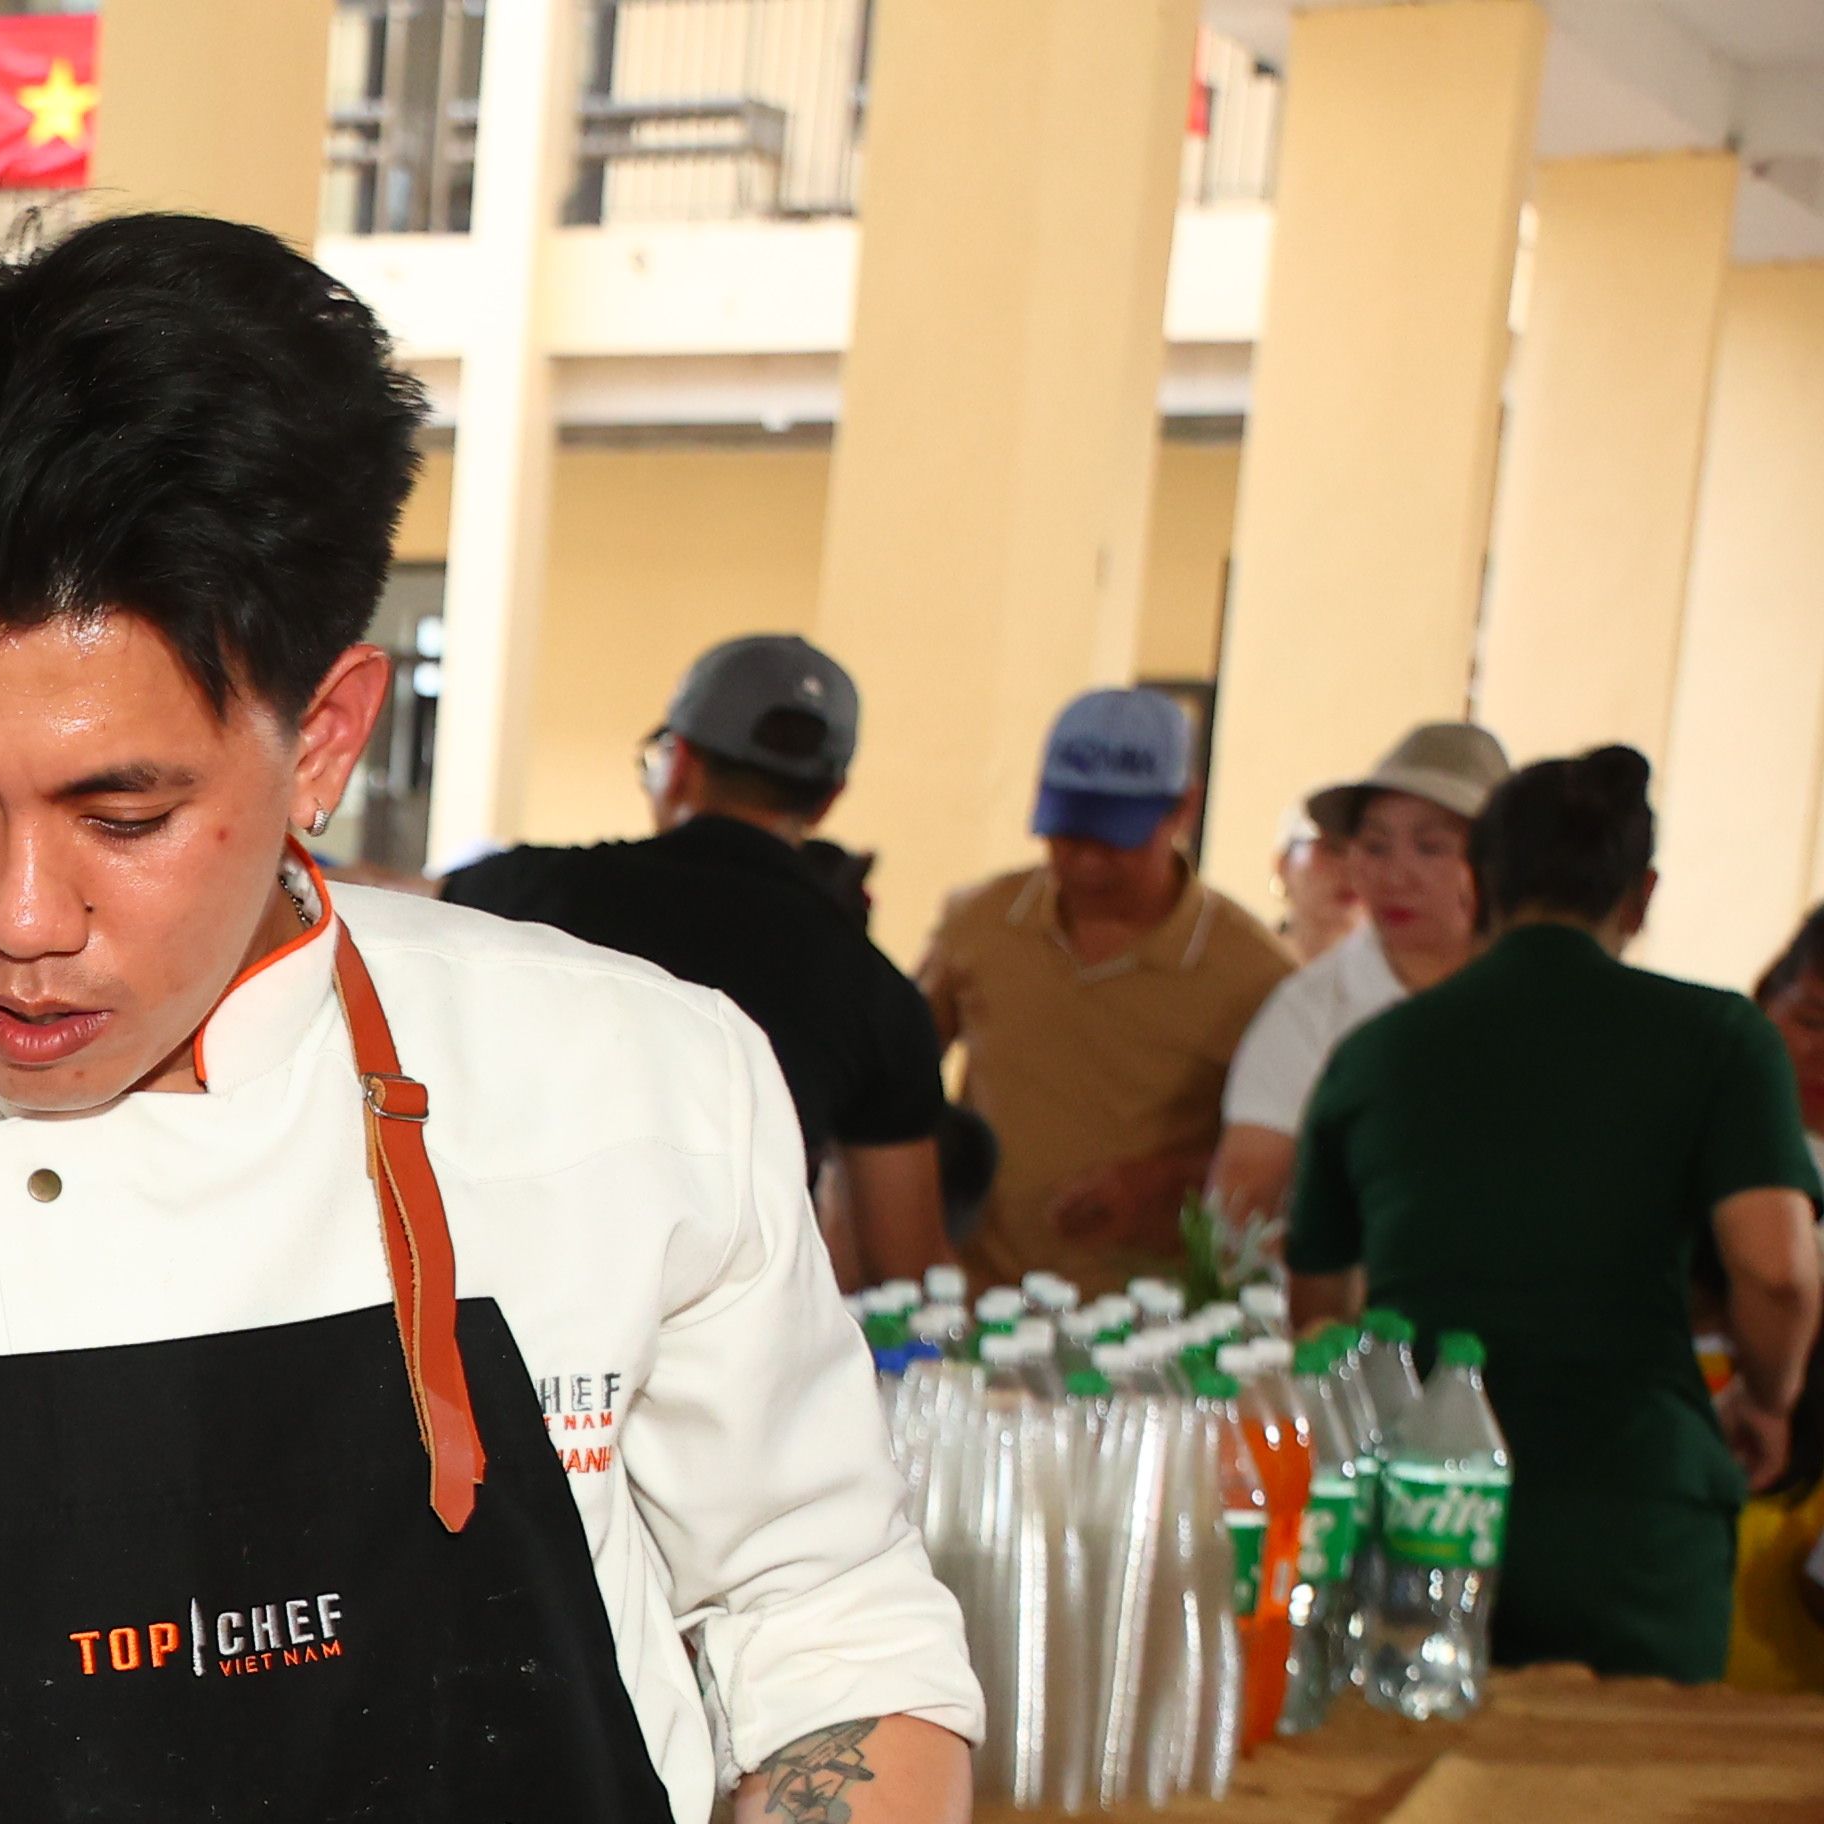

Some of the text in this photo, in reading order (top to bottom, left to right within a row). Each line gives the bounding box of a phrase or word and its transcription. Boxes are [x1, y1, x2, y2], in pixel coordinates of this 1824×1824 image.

[538, 1372, 621, 1414] HEF
[564, 1411, 613, 1430] NAM
[557, 1446, 613, 1473] ANH
[69, 1593, 343, 1675] TOP CHEF
[218, 1639, 342, 1677] VIET NAM
